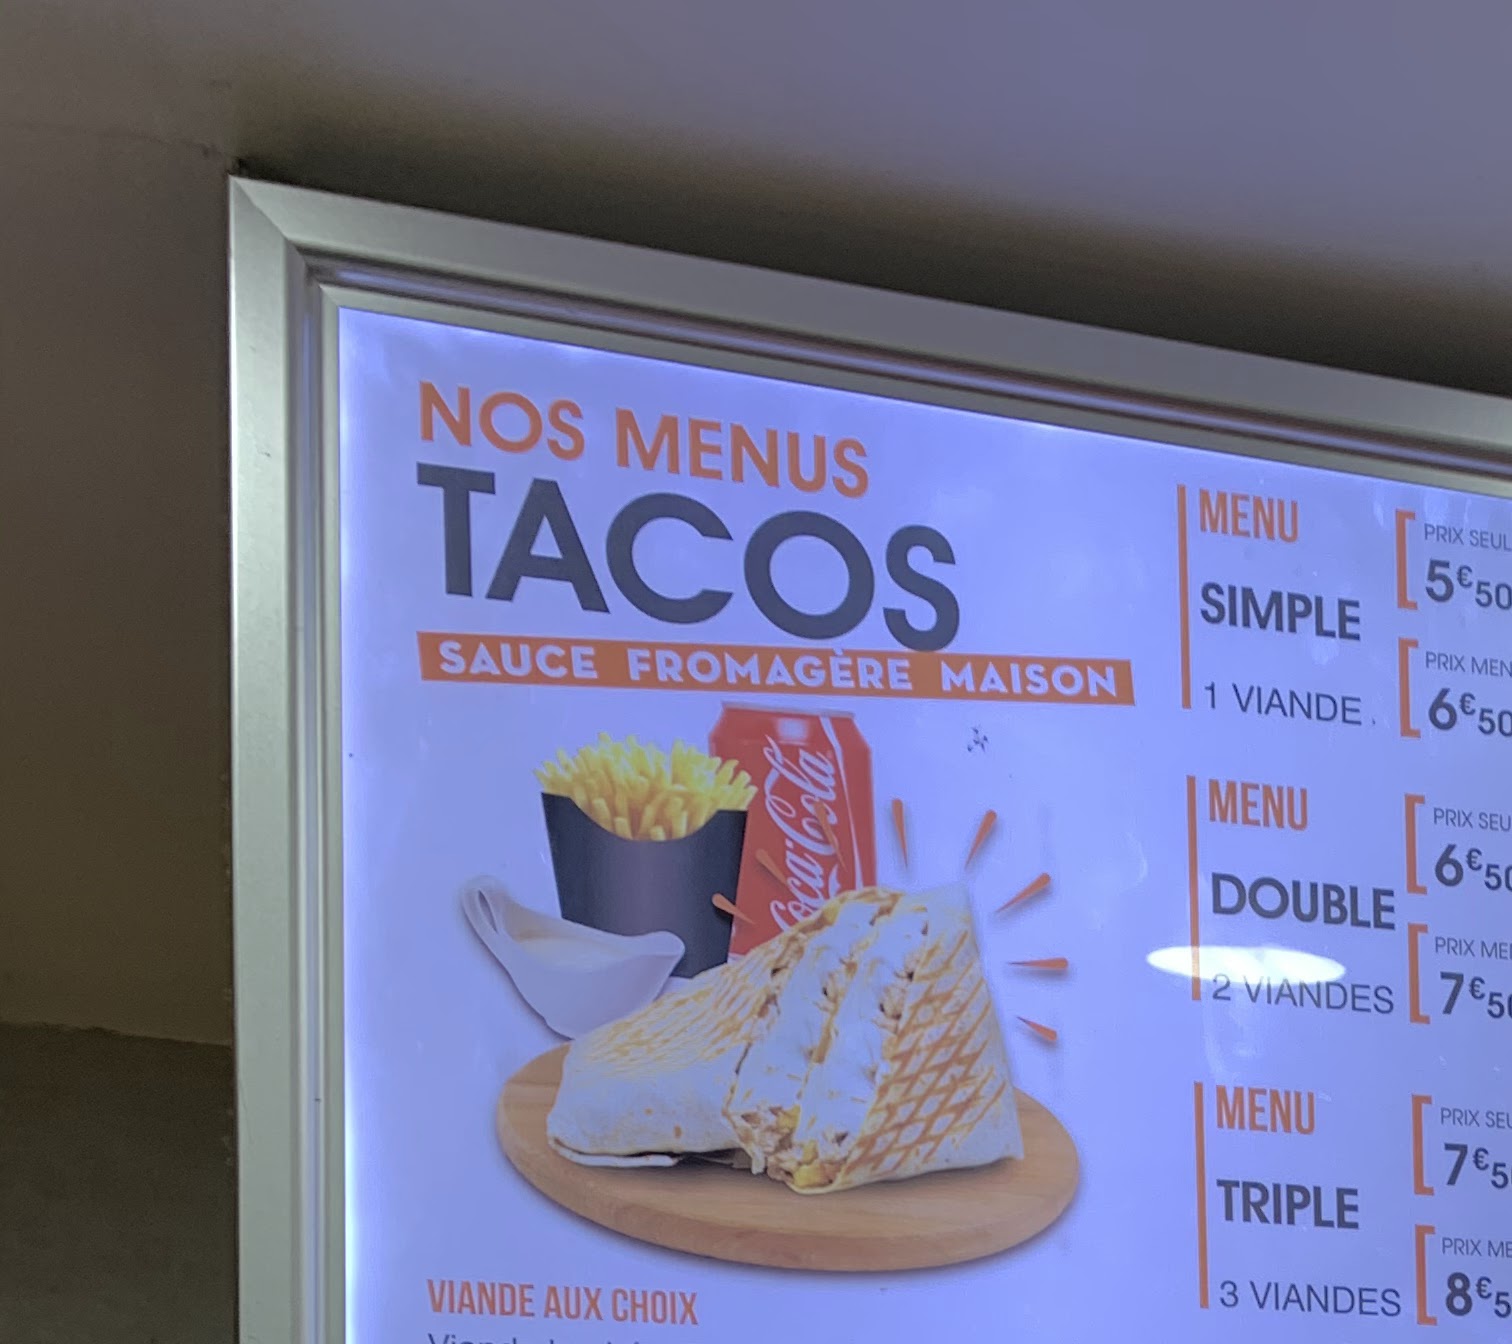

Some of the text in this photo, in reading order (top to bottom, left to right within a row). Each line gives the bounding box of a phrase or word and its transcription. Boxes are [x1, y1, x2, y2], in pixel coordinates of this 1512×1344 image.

[419, 381, 869, 498] NOS MENUS
[1200, 489, 1299, 543] MENU
[1424, 524, 1512, 552] PRIX SEUL
[416, 462, 961, 652] TACOS
[1200, 582, 1361, 641] SIMPLE
[439, 640, 1117, 697] SAUCE FROMAGÈRE MAISON
[1425, 651, 1464, 673] PRIX
[1204, 682, 1363, 726] 1 VIANDE
[1208, 779, 1308, 831] MENU
[1433, 808, 1473, 829] PRIX
[1211, 872, 1395, 930] DOUBLE
[1434, 937, 1475, 958] PRIX
[1212, 973, 1394, 1015] 2 VIANDES
[1216, 1085, 1315, 1135] MENU
[1440, 1107, 1480, 1127] PRIX
[1216, 1179, 1360, 1230] TRIPLE
[1441, 1237, 1482, 1257] PRIX
[426, 1278, 698, 1325] VIANDE AUX CHOIX
[1219, 1280, 1401, 1317] 3 VIANDES
